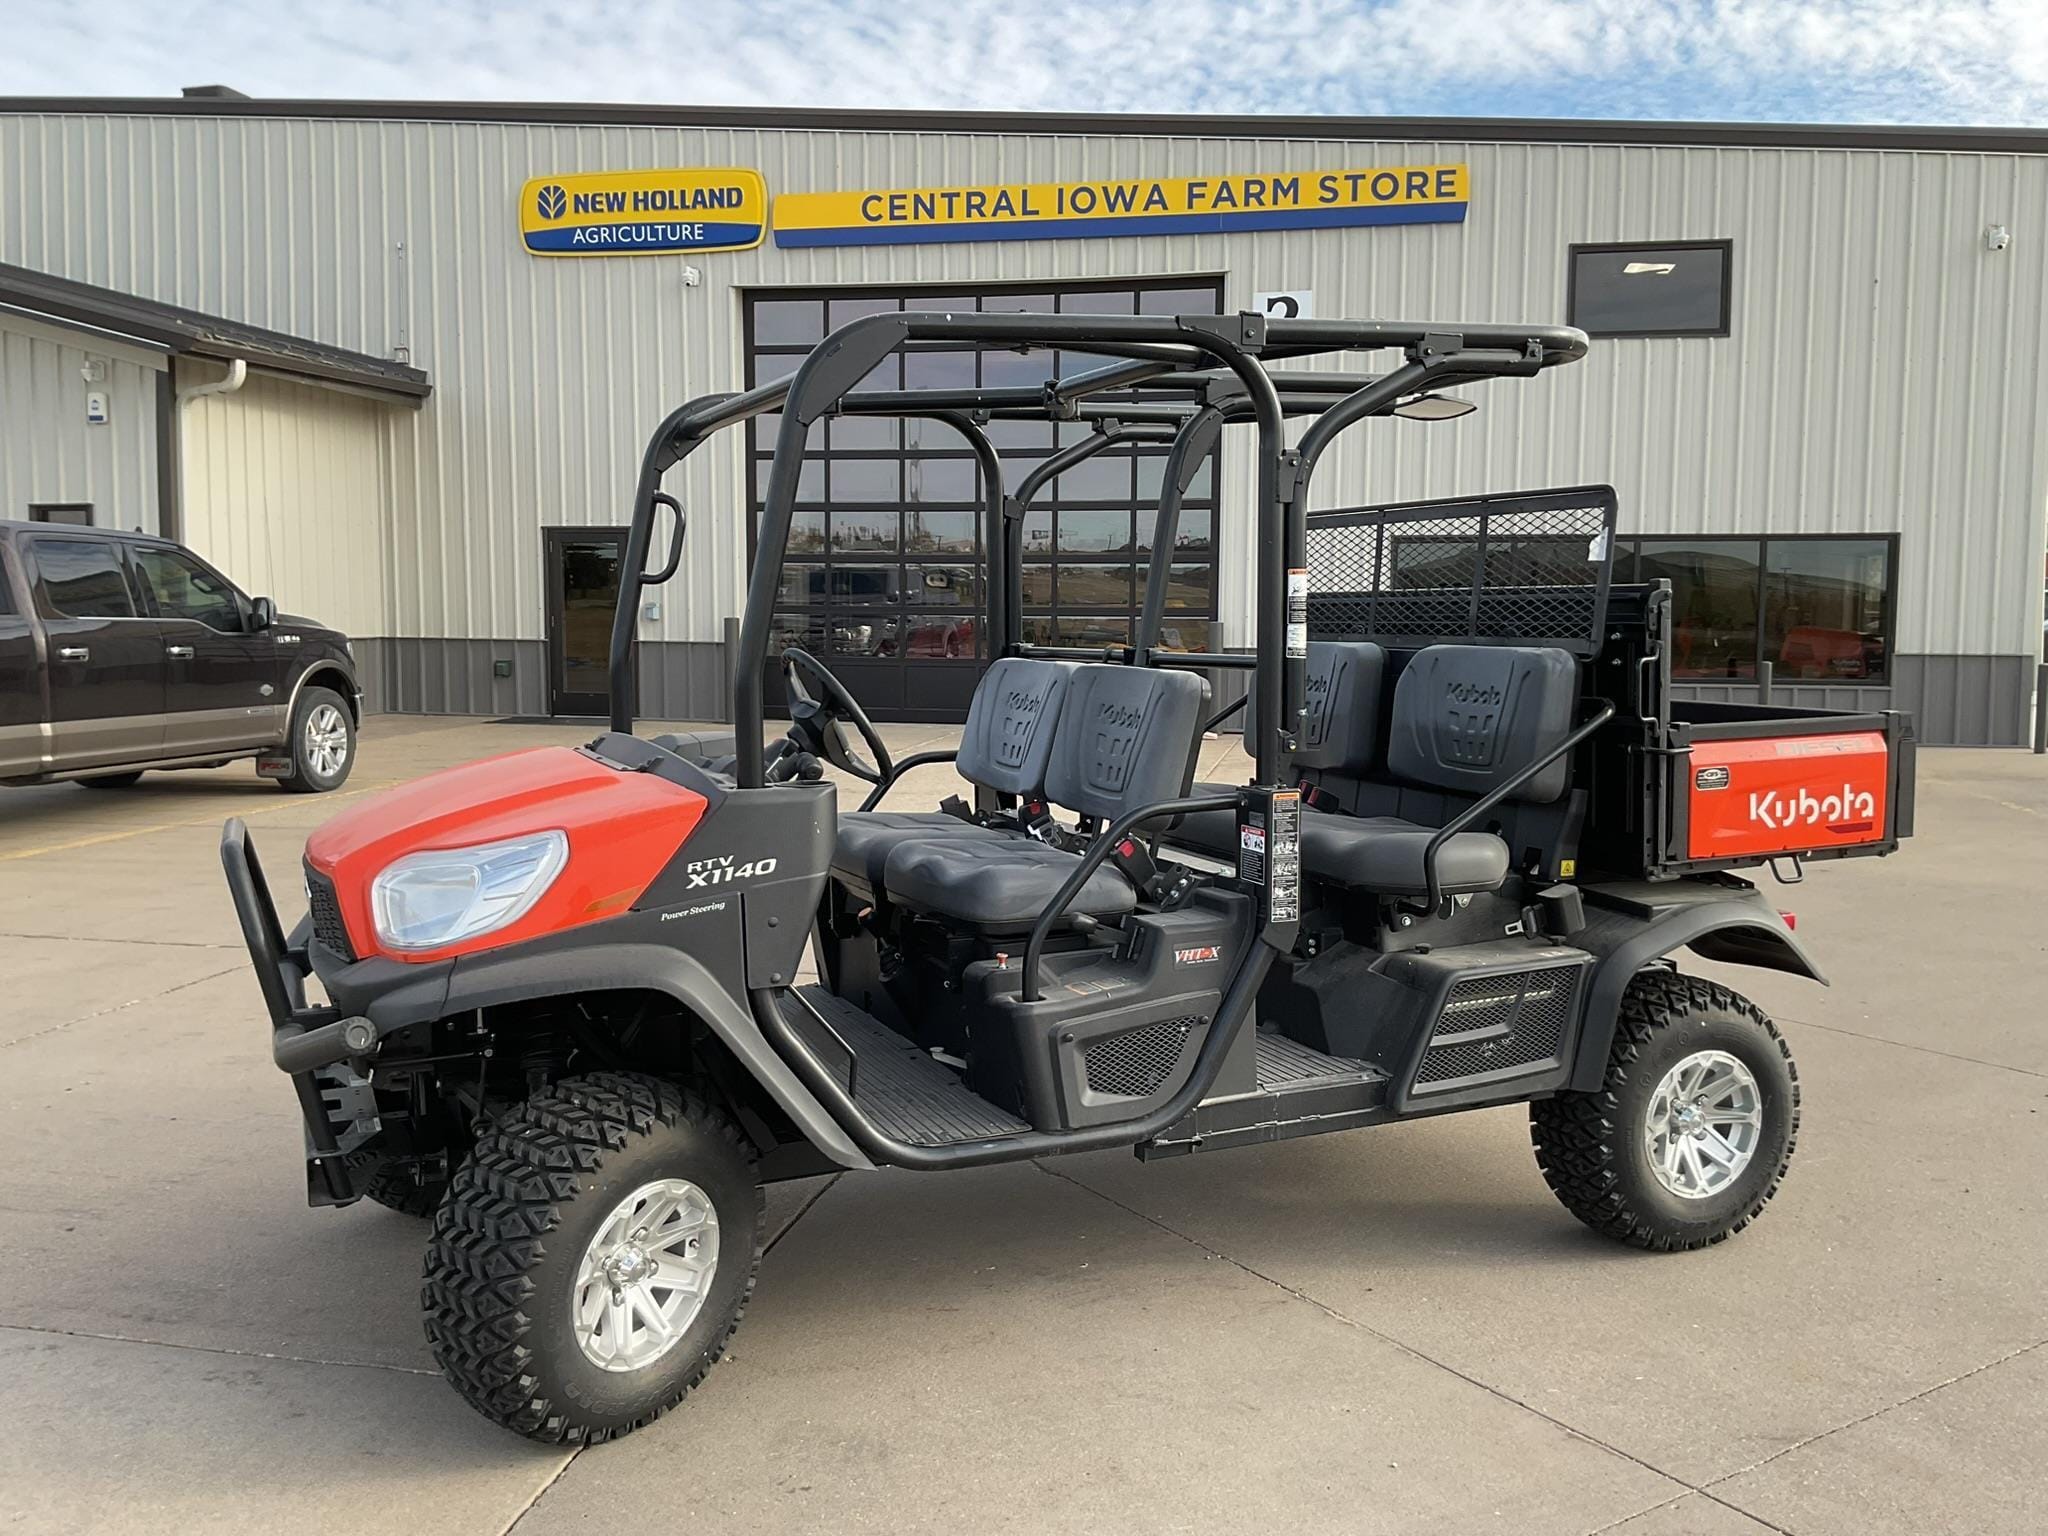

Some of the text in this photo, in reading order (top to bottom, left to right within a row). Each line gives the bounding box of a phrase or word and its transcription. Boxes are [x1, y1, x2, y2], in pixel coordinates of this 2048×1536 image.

[573, 187, 743, 214] NEW HOLLAND
[861, 170, 1457, 222] CENTRAL IOWA FARM STORE
[573, 223, 704, 244] AGRICULTURE
[1750, 783, 1875, 829] Kubota
[685, 858, 777, 889] X1140
[686, 854, 735, 873] RTV
[660, 901, 726, 921] Power Steering
